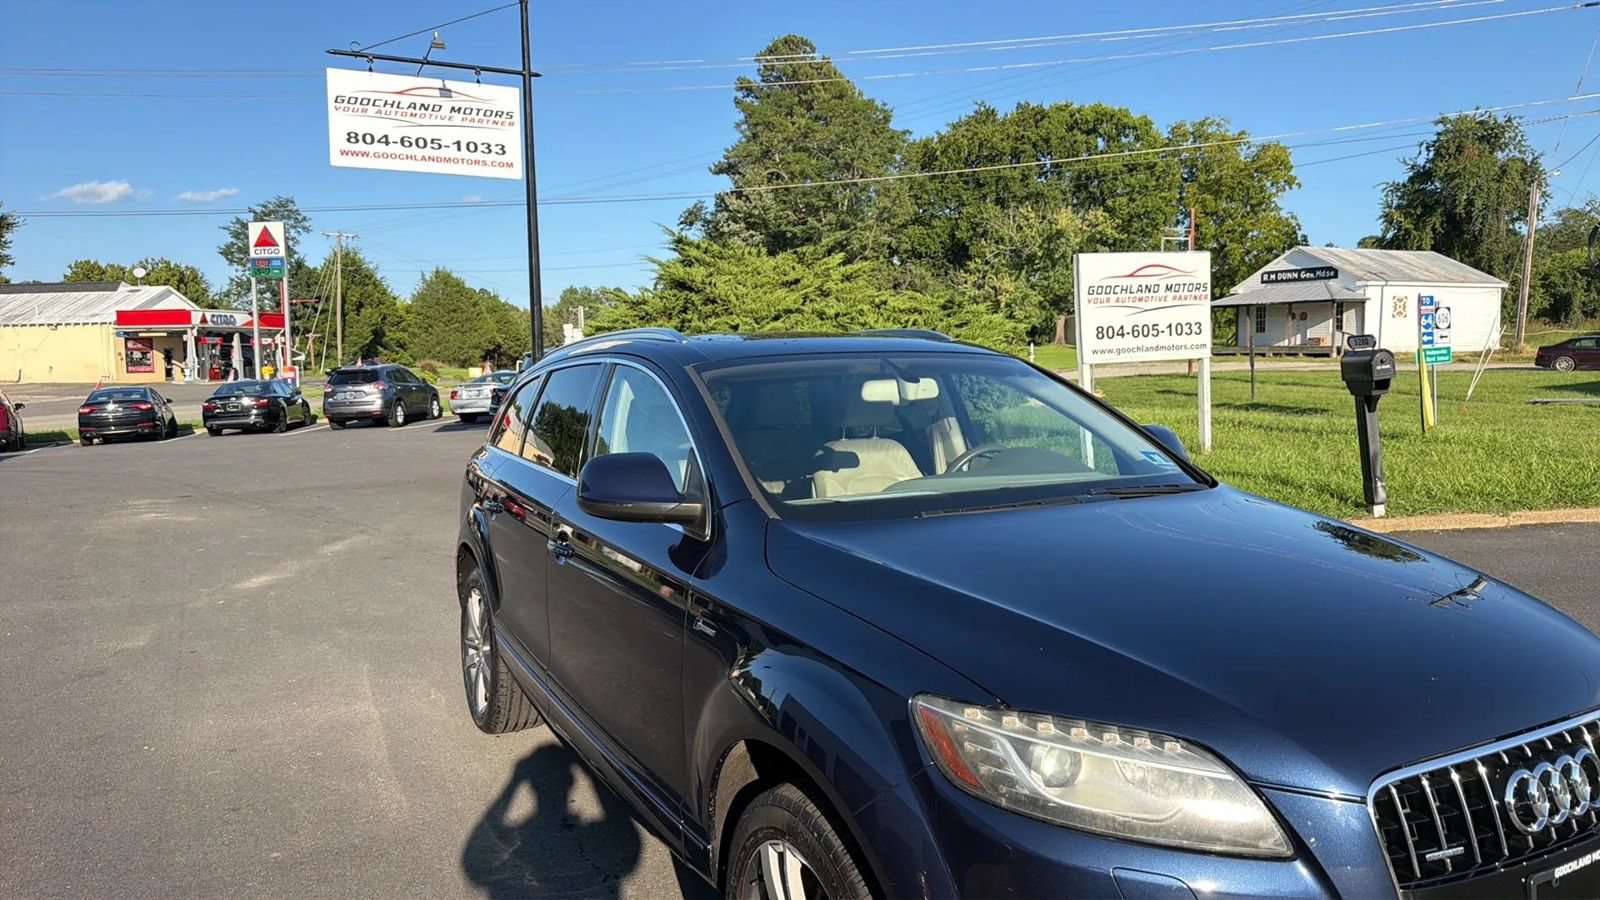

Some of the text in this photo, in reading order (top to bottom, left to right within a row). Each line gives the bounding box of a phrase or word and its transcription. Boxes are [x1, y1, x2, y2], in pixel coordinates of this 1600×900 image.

[334, 95, 514, 120] GOOCHLAND MOTORS
[333, 105, 515, 127] YOUR AUTOMOTIVE PARTNER
[346, 131, 507, 156] 804-605-1033
[339, 149, 514, 169] WWW.GOOCHLANDMOTORS.COM
[1277, 272, 1298, 280] DUNN
[1087, 282, 1208, 296] GOOCHLAND MOTORS
[1114, 295, 1168, 304] AUTOMOTIVE
[1172, 294, 1209, 302] PARTNER
[210, 314, 237, 326] CITGO
[1421, 314, 1433, 327] 64
[1095, 321, 1203, 340] 804-605-1033
[1091, 343, 1207, 355] www.goochlandmotors.com
[1554, 854, 1592, 878] GOOCHLAND
